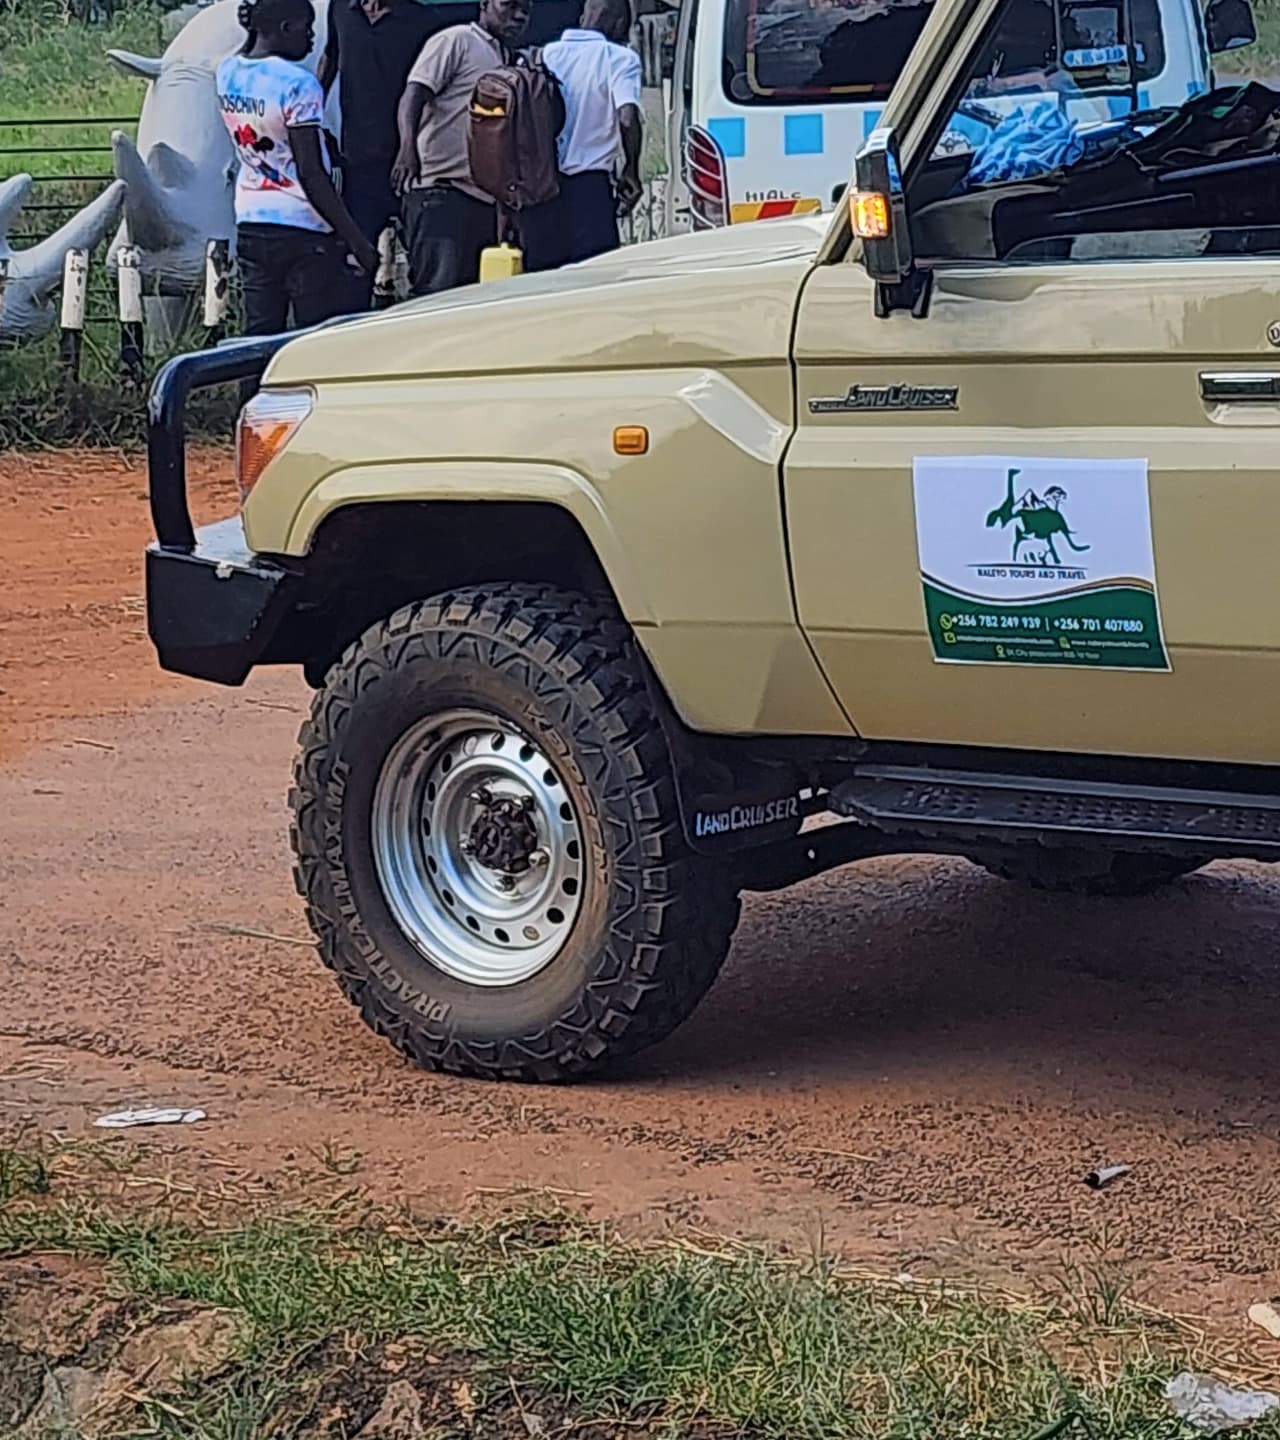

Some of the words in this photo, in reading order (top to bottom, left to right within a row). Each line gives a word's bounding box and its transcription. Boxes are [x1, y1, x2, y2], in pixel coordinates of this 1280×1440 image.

[979, 615, 998, 627] 782
[1000, 616, 1019, 628] 249
[1021, 617, 1041, 629] 939
[1082, 619, 1101, 631] 701
